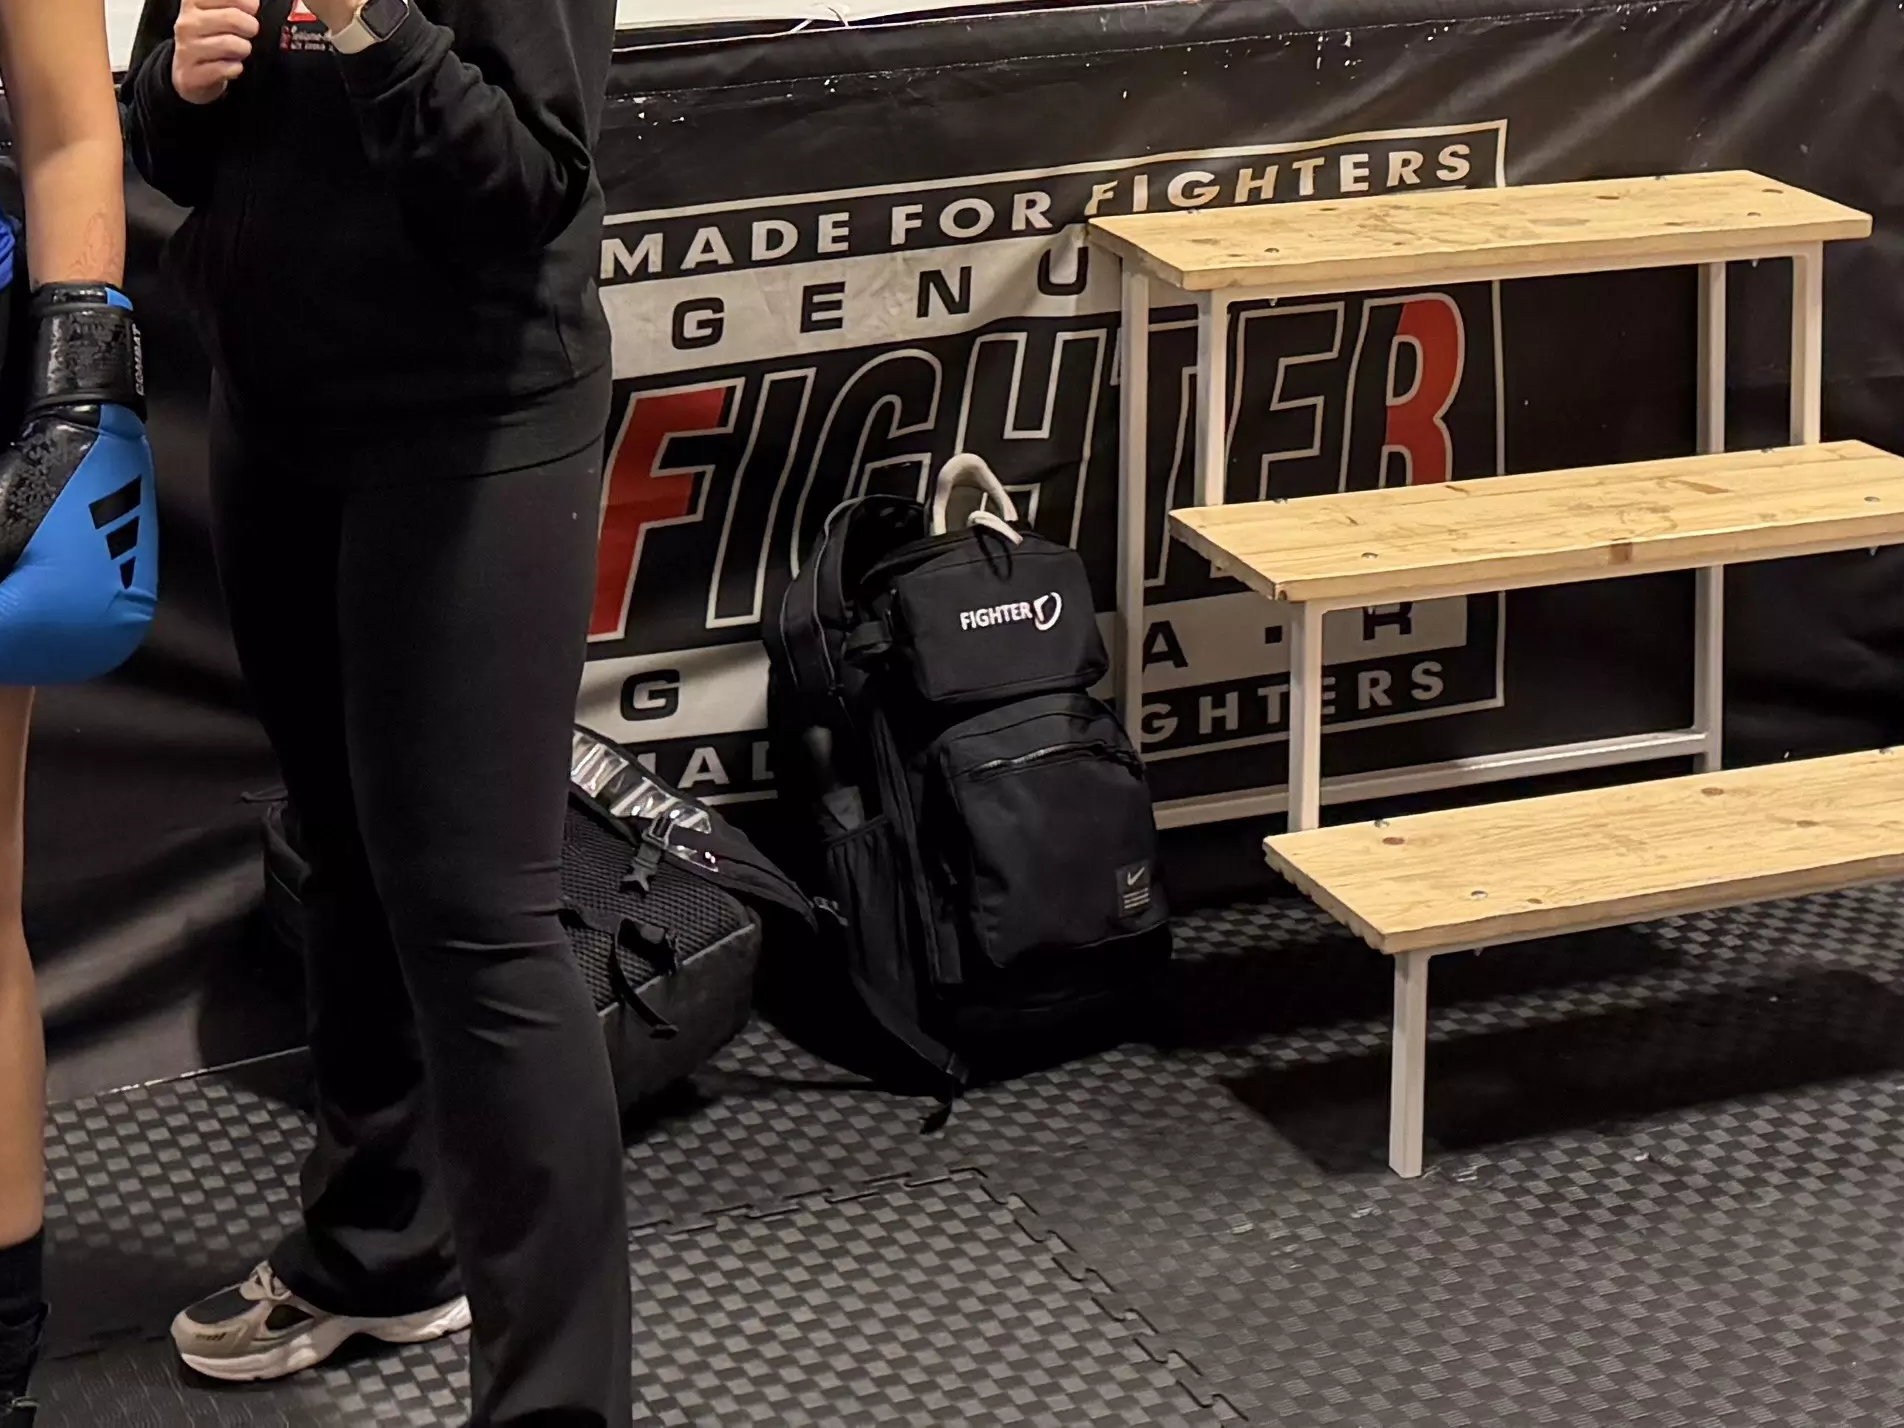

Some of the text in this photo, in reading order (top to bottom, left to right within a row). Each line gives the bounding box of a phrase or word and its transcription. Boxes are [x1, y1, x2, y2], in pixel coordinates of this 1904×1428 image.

[599, 144, 1472, 280] MADE FOR FIGHTERS
[959, 601, 1033, 631] FIGHTER
